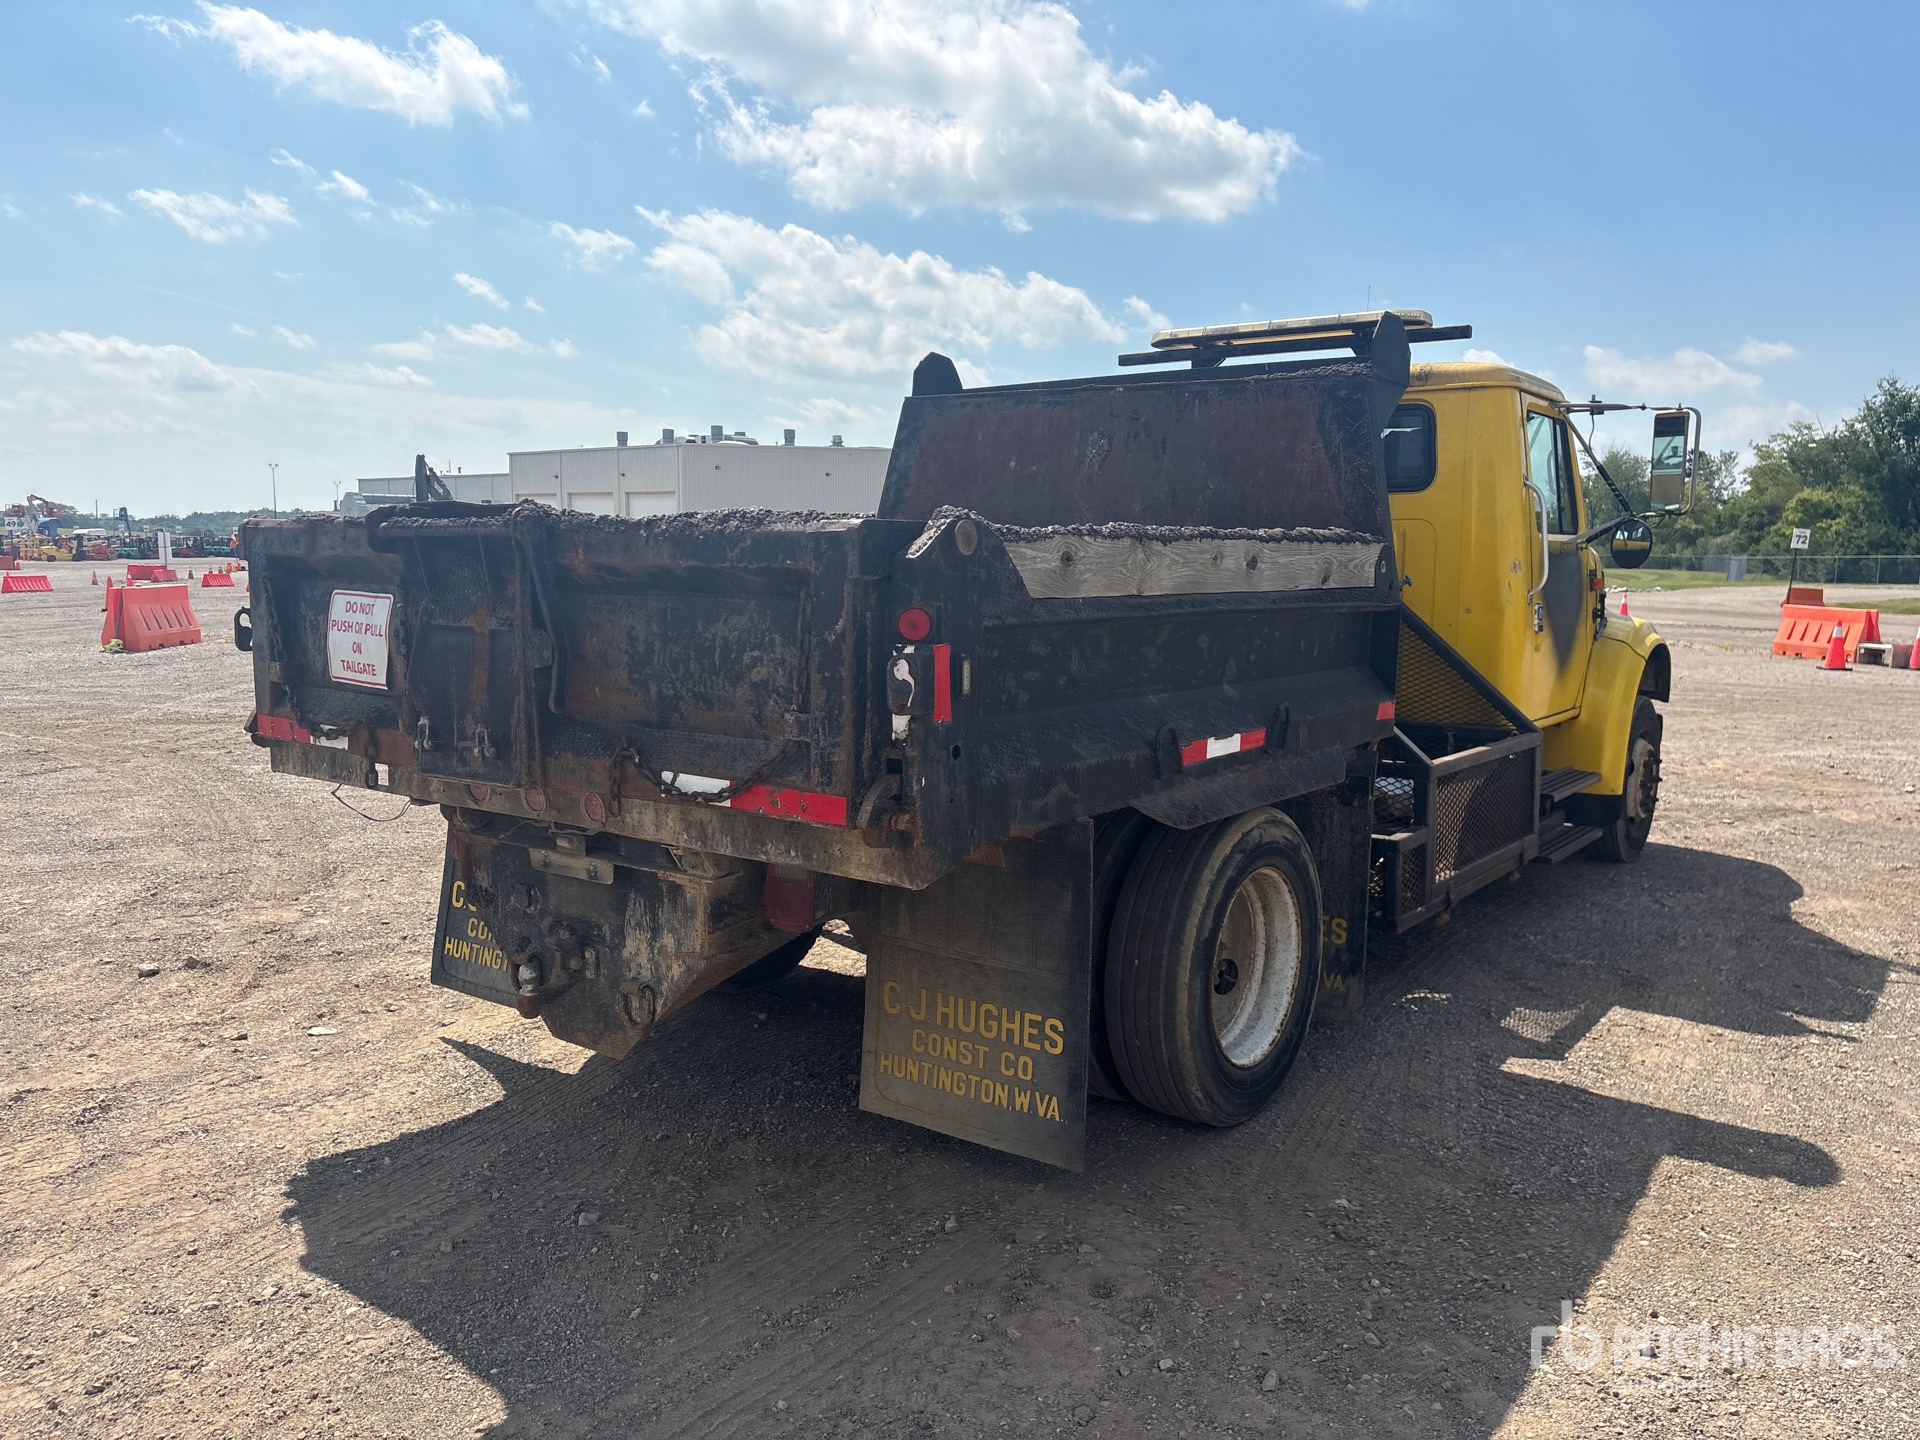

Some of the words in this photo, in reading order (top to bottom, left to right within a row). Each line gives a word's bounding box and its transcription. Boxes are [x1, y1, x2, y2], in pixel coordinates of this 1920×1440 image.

[5, 520, 17, 528] 49
[1795, 534, 1808, 544] 72
[345, 600, 358, 614] DO
[359, 602, 375, 616] NOT
[331, 619, 353, 634] PUSH
[354, 621, 363, 635] OR
[364, 623, 384, 637] PULL
[352, 641, 363, 655] ON
[340, 659, 377, 677] TAILGATE
[936, 992, 1065, 1055] HUGHES
